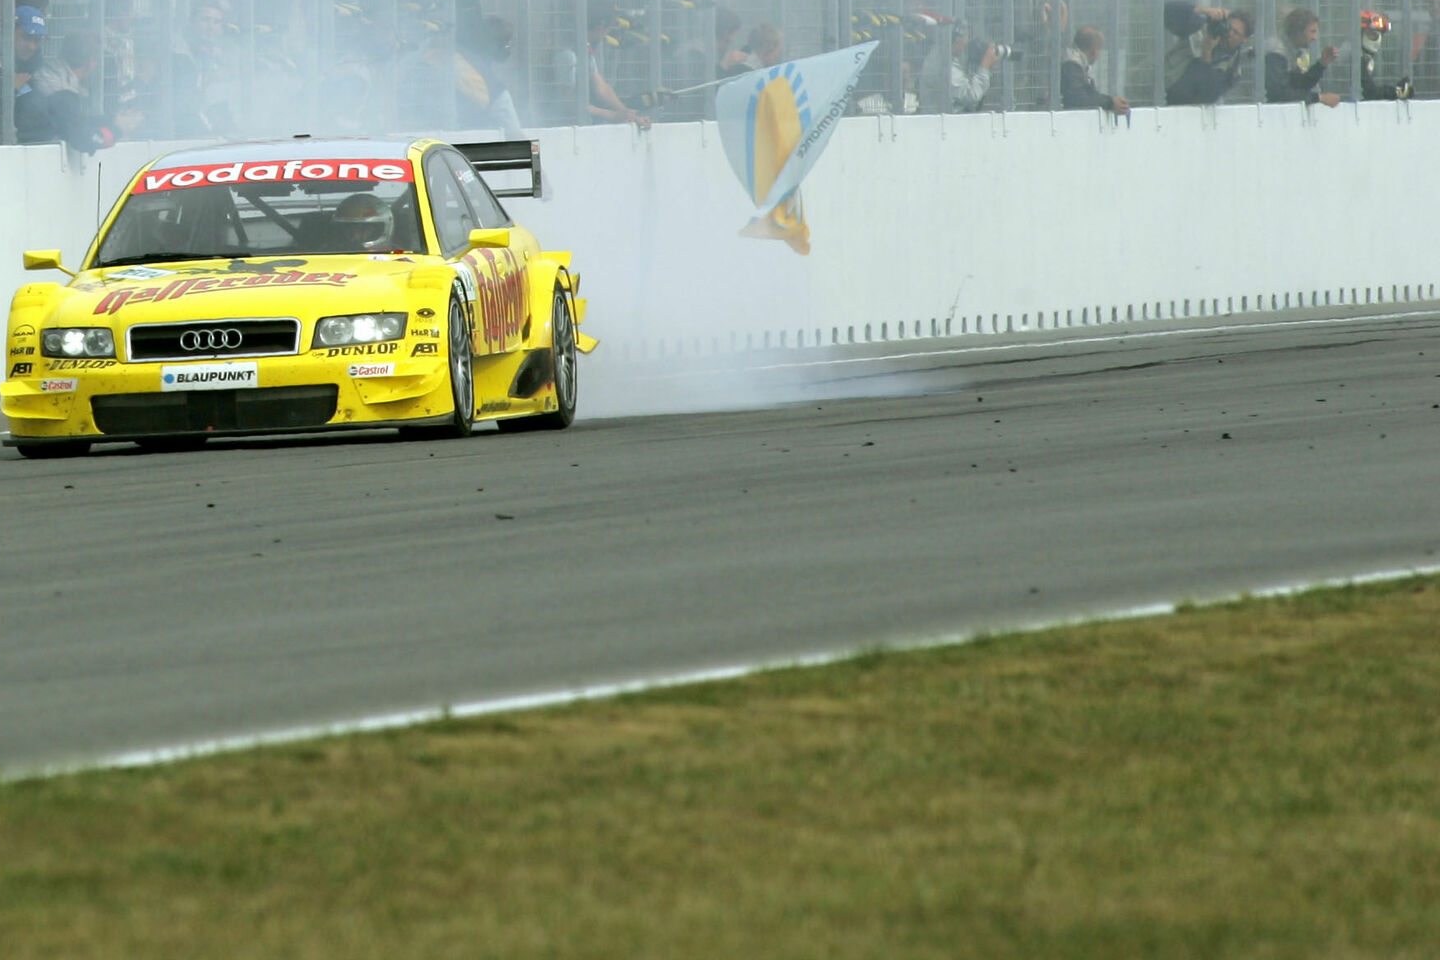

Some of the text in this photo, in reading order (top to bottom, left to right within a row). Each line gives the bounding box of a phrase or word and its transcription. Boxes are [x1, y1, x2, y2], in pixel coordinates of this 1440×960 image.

[144, 160, 406, 190] vodafone
[326, 343, 398, 358] DUNLOP
[410, 342, 439, 357] ABT
[9, 362, 33, 378] ABT
[48, 359, 118, 371] DUNLOP
[357, 365, 389, 377] Castrol
[176, 370, 255, 383] BLAUPUNKT
[46, 380, 73, 390] Castrol
